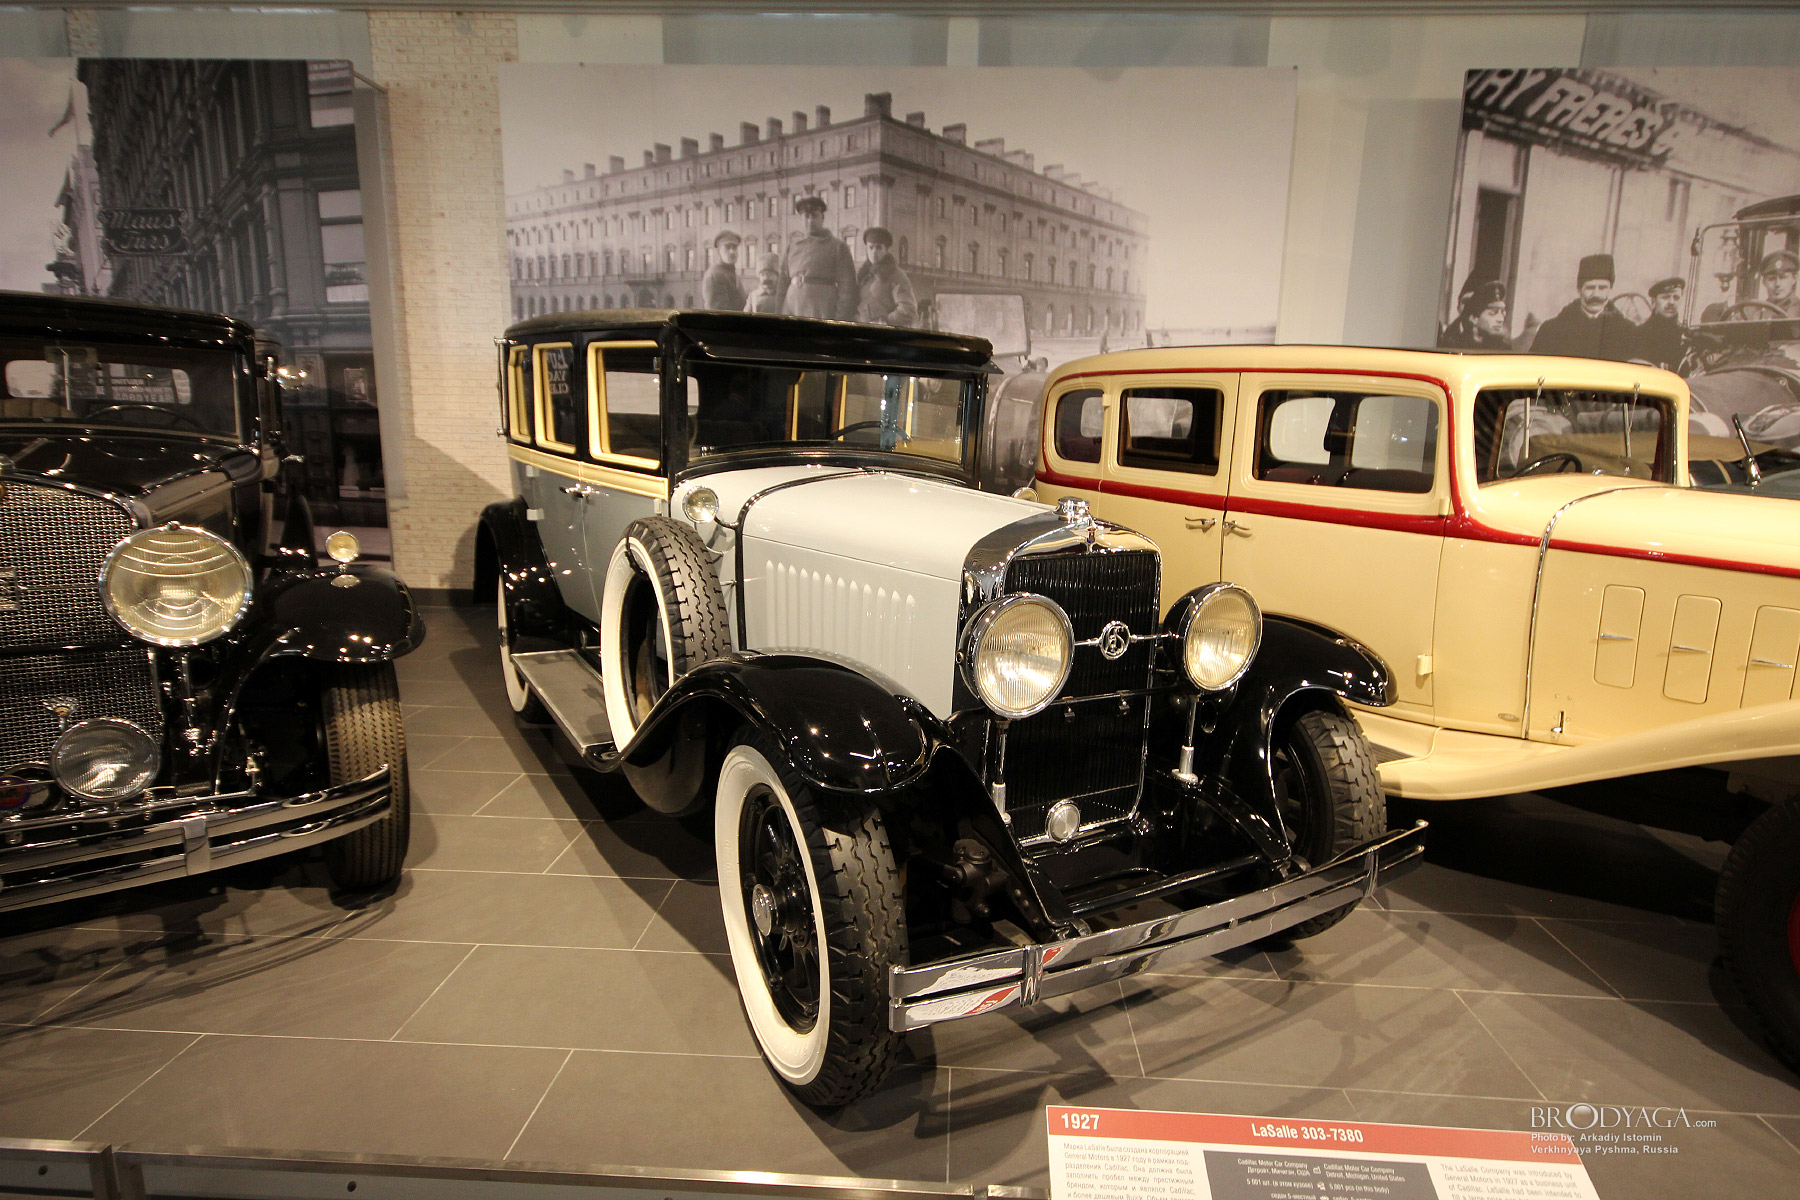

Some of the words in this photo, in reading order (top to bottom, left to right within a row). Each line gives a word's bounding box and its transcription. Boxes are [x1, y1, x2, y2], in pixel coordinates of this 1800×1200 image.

[1061, 1112, 1100, 1130] 1927
[1251, 1123, 1299, 1139] LaSalle
[1301, 1126, 1364, 1143] 303-7380
